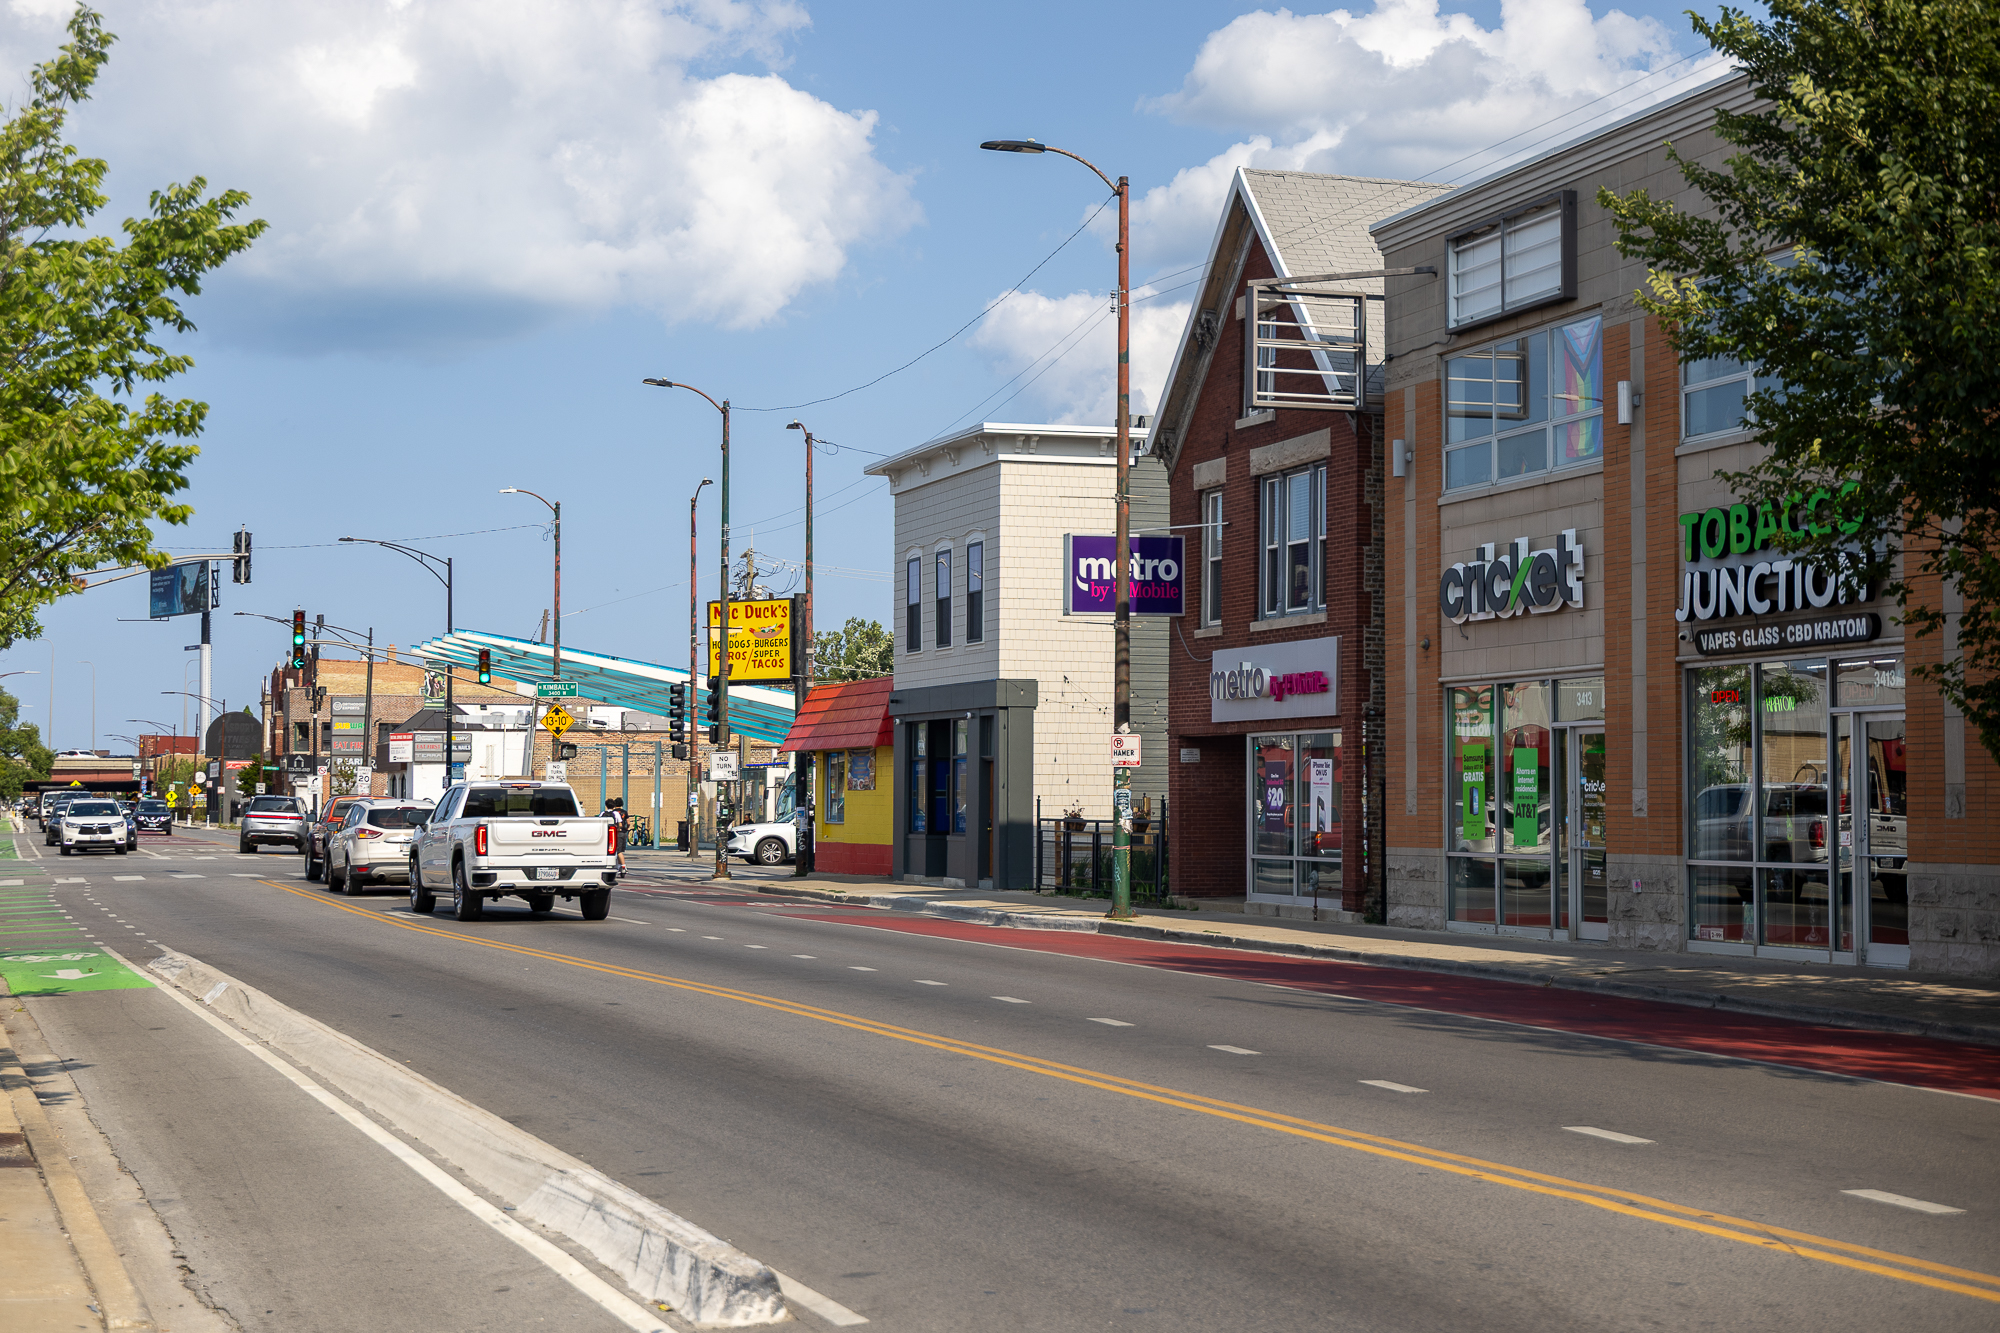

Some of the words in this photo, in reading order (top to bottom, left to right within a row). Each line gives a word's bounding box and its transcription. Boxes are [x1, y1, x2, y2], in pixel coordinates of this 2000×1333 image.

[1679, 480, 1864, 562] TOBACCO
[1440, 534, 1576, 620] cricket
[1090, 582, 1110, 602] by
[1113, 582, 1179, 598] Mobile
[1675, 550, 1867, 622] JUNCTION
[745, 604, 788, 619] Duck's
[1701, 631, 1736, 651] VAPES
[1742, 626, 1780, 647] GLASS
[1786, 622, 1812, 642] CBD
[1814, 617, 1866, 640] KRATOM
[729, 640, 750, 648] DOGS
[755, 638, 788, 648] BURGERS
[715, 651, 747, 660] GROS
[754, 650, 780, 658] SUPER
[752, 658, 784, 669] TACOS
[1210, 662, 1266, 700] metro
[1577, 691, 1592, 706] 3413
[1711, 690, 1739, 704] OPEN
[1464, 754, 1484, 764] Samsung
[1463, 771, 1484, 782] GRATIS
[1518, 776, 1534, 784] internet
[1267, 787, 1284, 807] $20
[1515, 803, 1537, 818] AT&T
